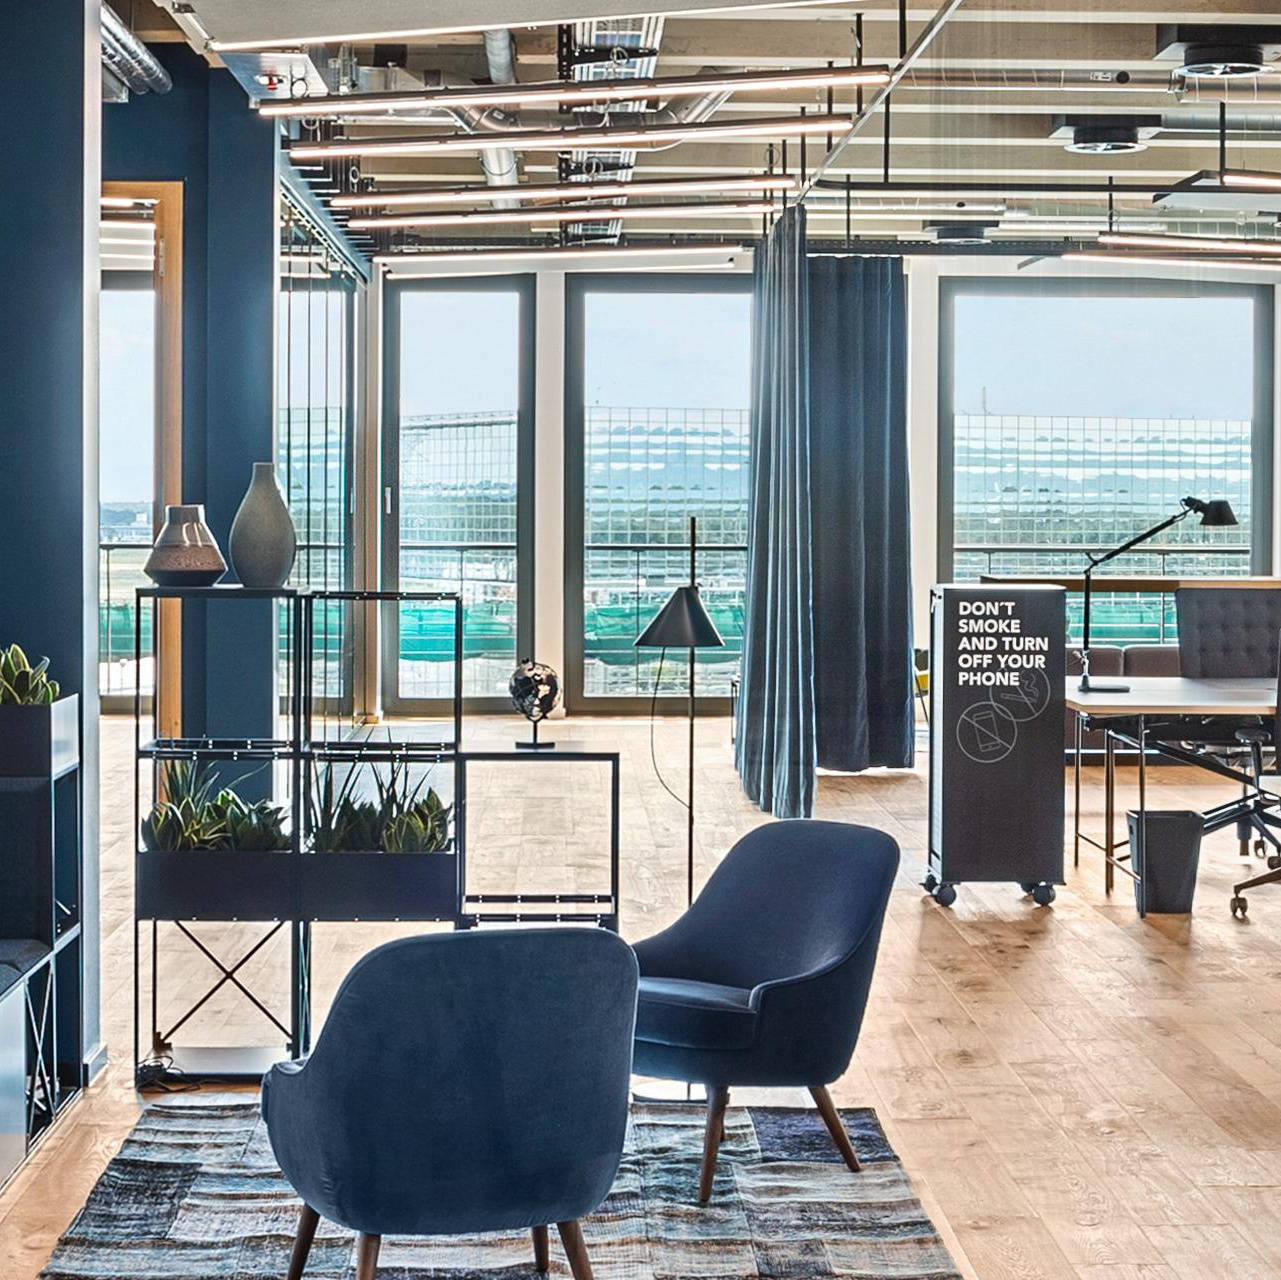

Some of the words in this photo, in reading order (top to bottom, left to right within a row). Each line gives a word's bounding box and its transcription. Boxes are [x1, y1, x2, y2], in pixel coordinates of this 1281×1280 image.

[958, 618, 1021, 633] SMOKE
[957, 636, 998, 651] AND
[1001, 636, 1049, 651] TURN
[957, 653, 993, 668] OFF
[996, 653, 1047, 669] YOUR
[958, 671, 1021, 686] PHONE
